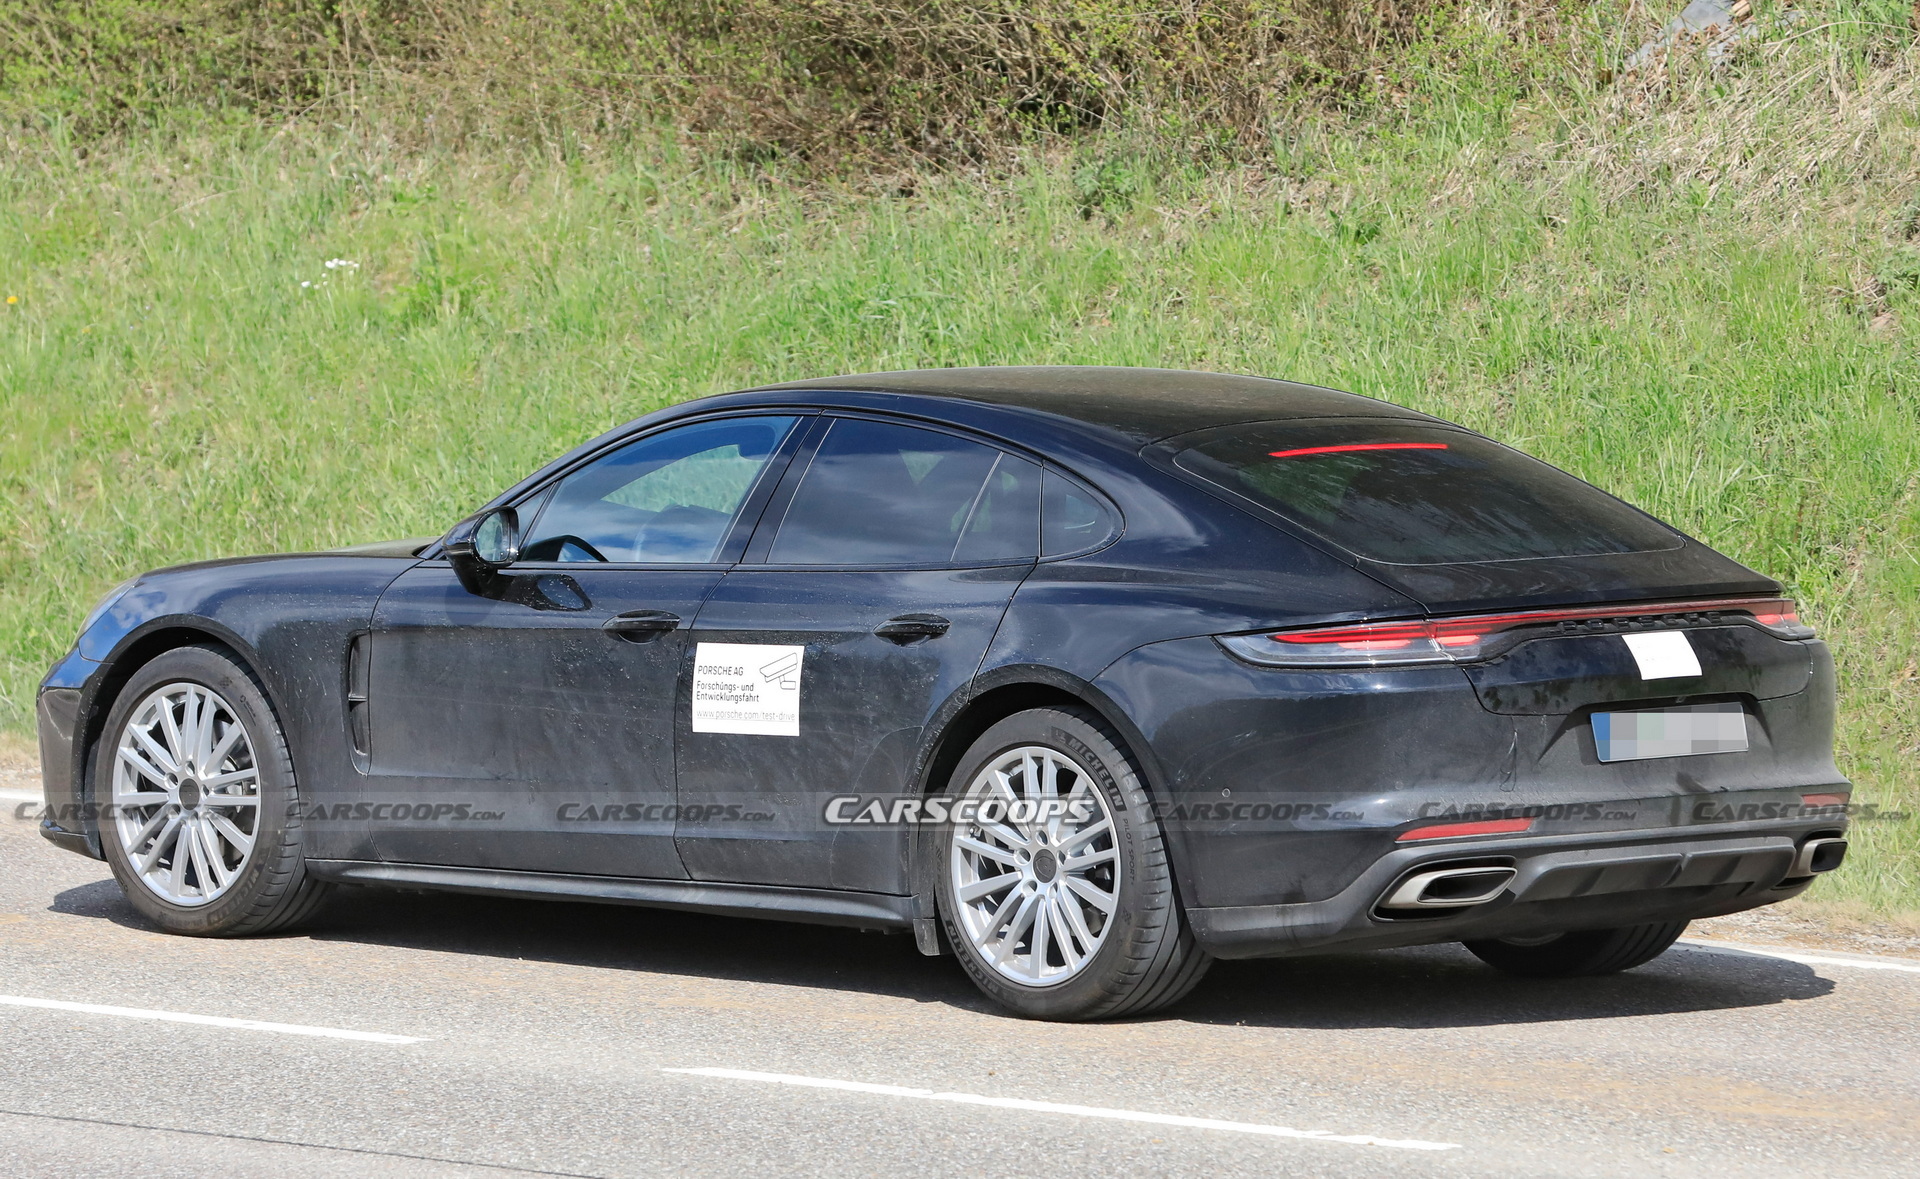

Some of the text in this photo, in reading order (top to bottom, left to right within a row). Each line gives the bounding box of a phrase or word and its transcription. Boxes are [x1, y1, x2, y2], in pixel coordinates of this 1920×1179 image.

[698, 665, 744, 676] PORSCHE AG
[696, 690, 760, 704] Entwicklungsfahrt
[741, 683, 754, 692] und
[1069, 737, 1124, 807] MICHELIN
[1122, 818, 1133, 846] PILOT
[947, 923, 999, 995] MICHELIN
